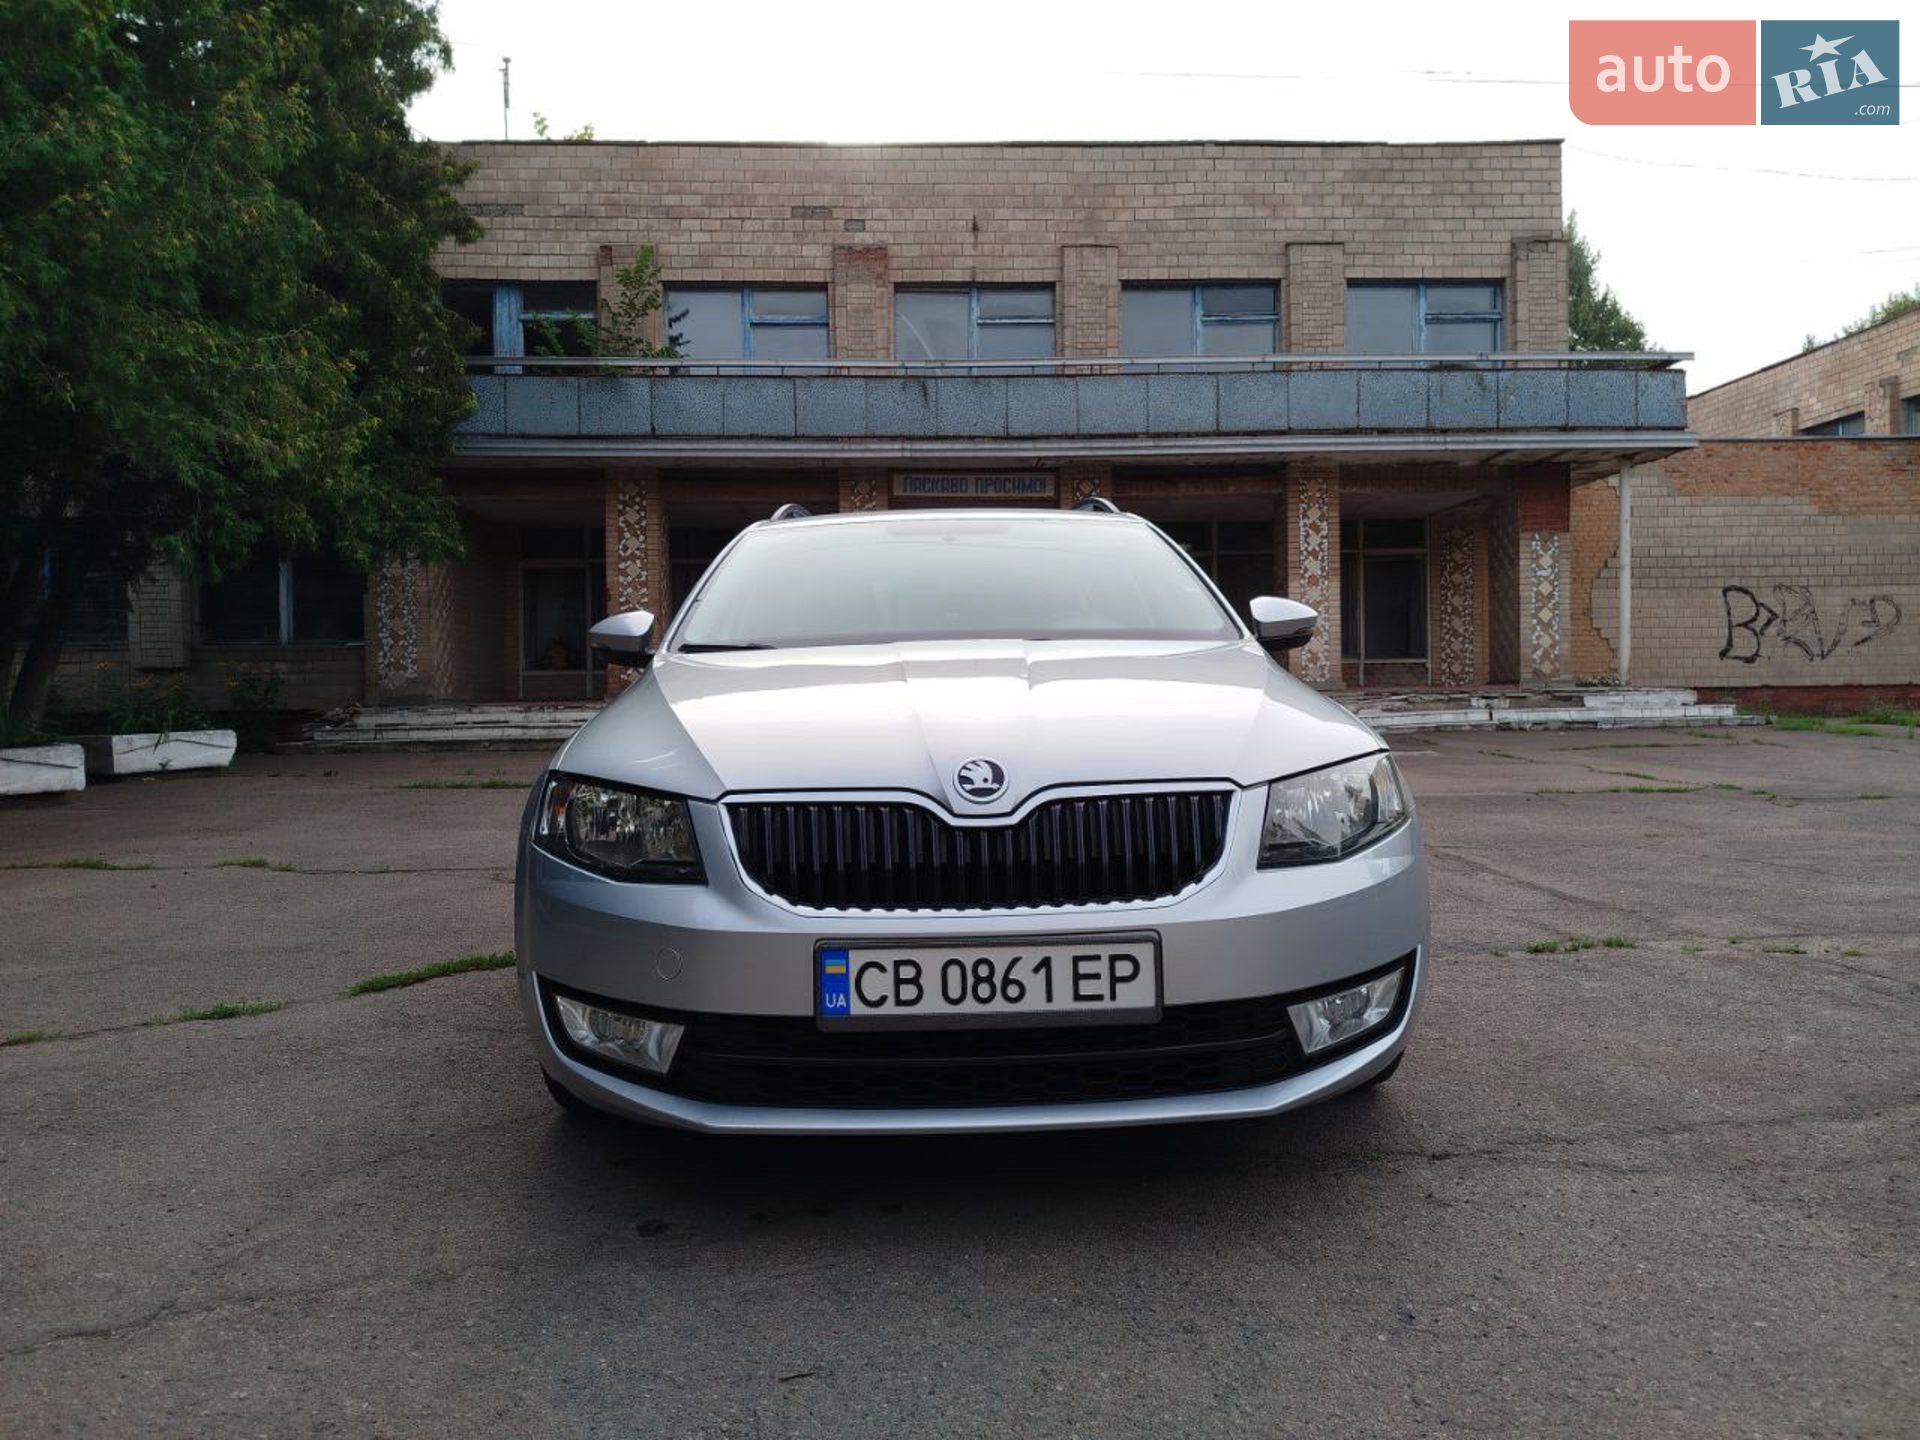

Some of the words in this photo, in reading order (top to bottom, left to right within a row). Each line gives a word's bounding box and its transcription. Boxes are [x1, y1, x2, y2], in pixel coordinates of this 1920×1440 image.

[974, 476, 1047, 494] ПРОСИМО!
[854, 959, 924, 1008] CB
[940, 956, 1053, 1006] 0861
[1072, 953, 1141, 1002] EP
[825, 992, 847, 1008] UA
